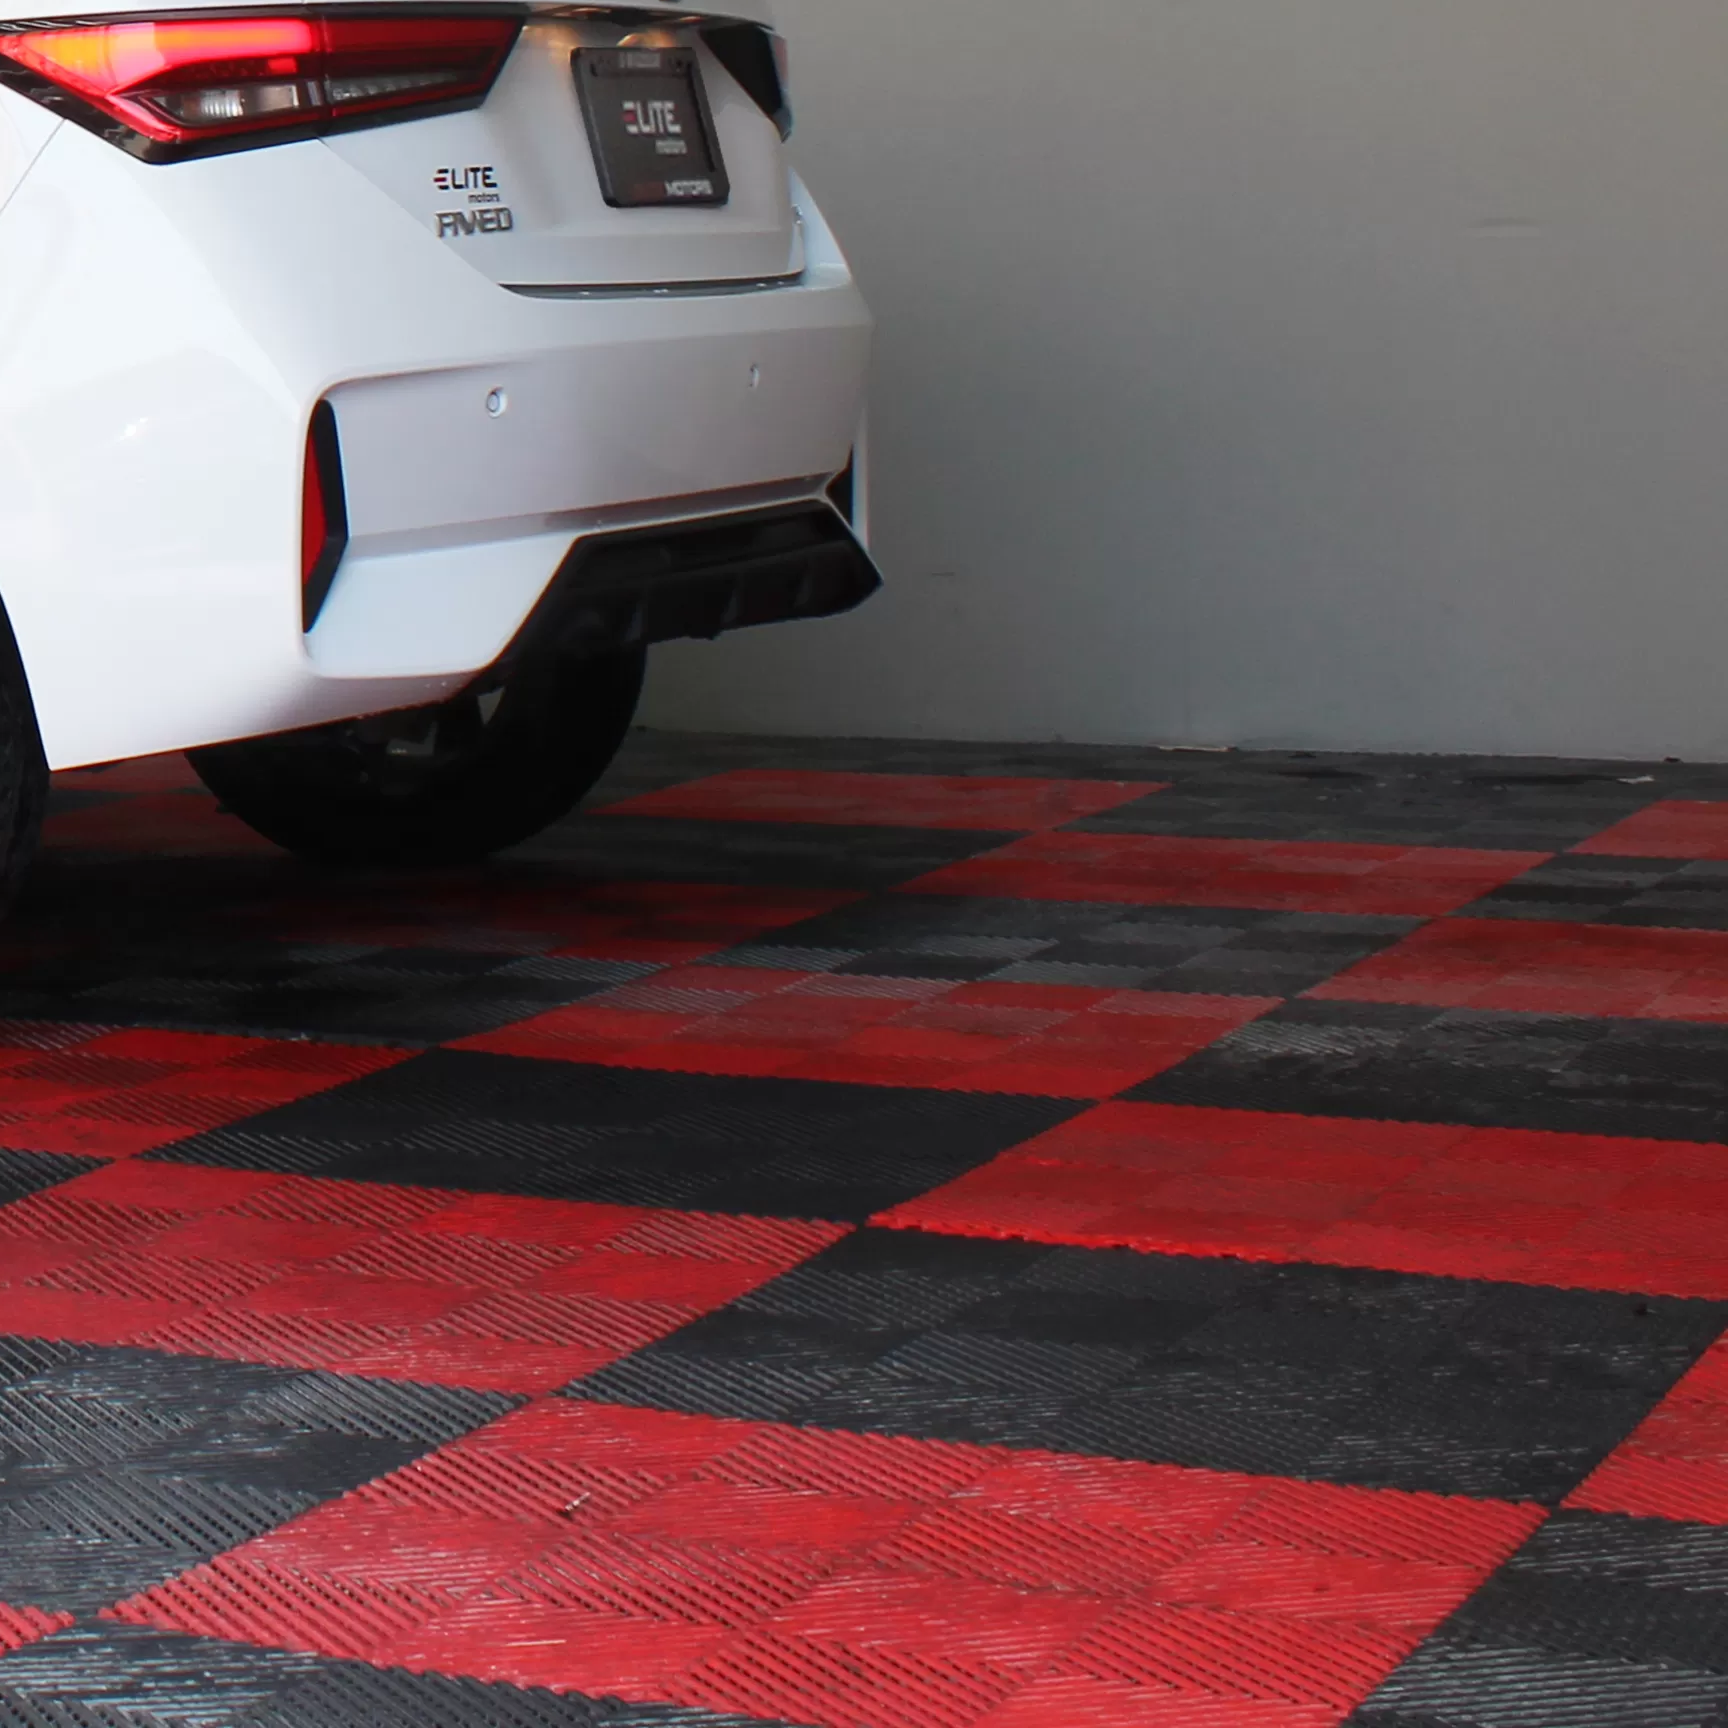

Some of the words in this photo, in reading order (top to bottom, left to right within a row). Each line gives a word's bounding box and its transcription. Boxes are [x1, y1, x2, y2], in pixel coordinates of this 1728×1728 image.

[622, 100, 681, 134] ELITE
[433, 165, 498, 190] ELITE
[664, 179, 713, 196] MOTORS
